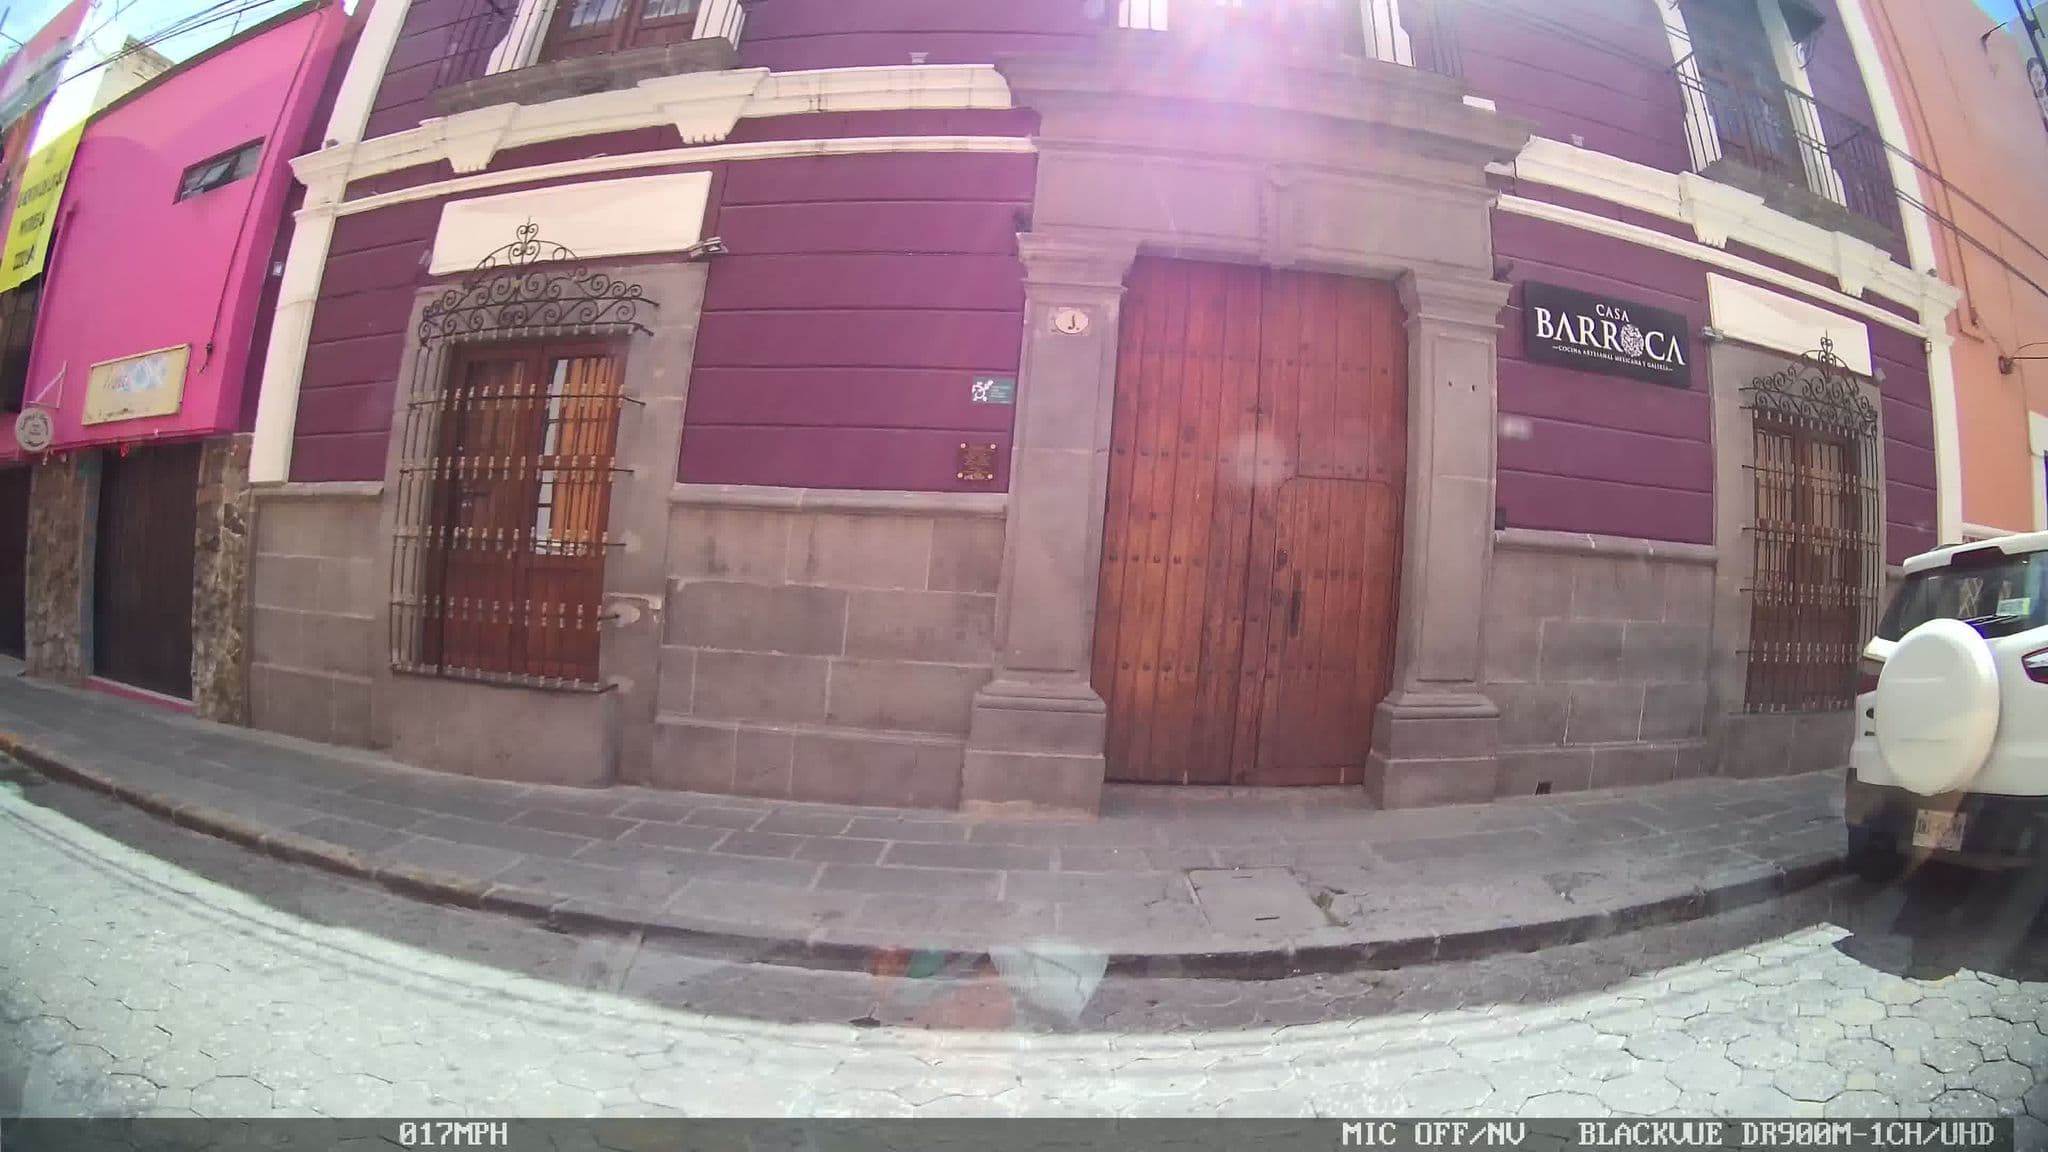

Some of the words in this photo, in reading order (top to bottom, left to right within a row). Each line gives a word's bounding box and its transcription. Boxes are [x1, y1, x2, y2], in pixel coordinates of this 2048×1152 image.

[1596, 304, 1629, 322] CASA
[1534, 307, 1686, 365] BARROCA
[1558, 345, 1581, 355] COCINA
[1583, 350, 1613, 360] ARTESANAL
[1614, 355, 1641, 366] MEXICANA
